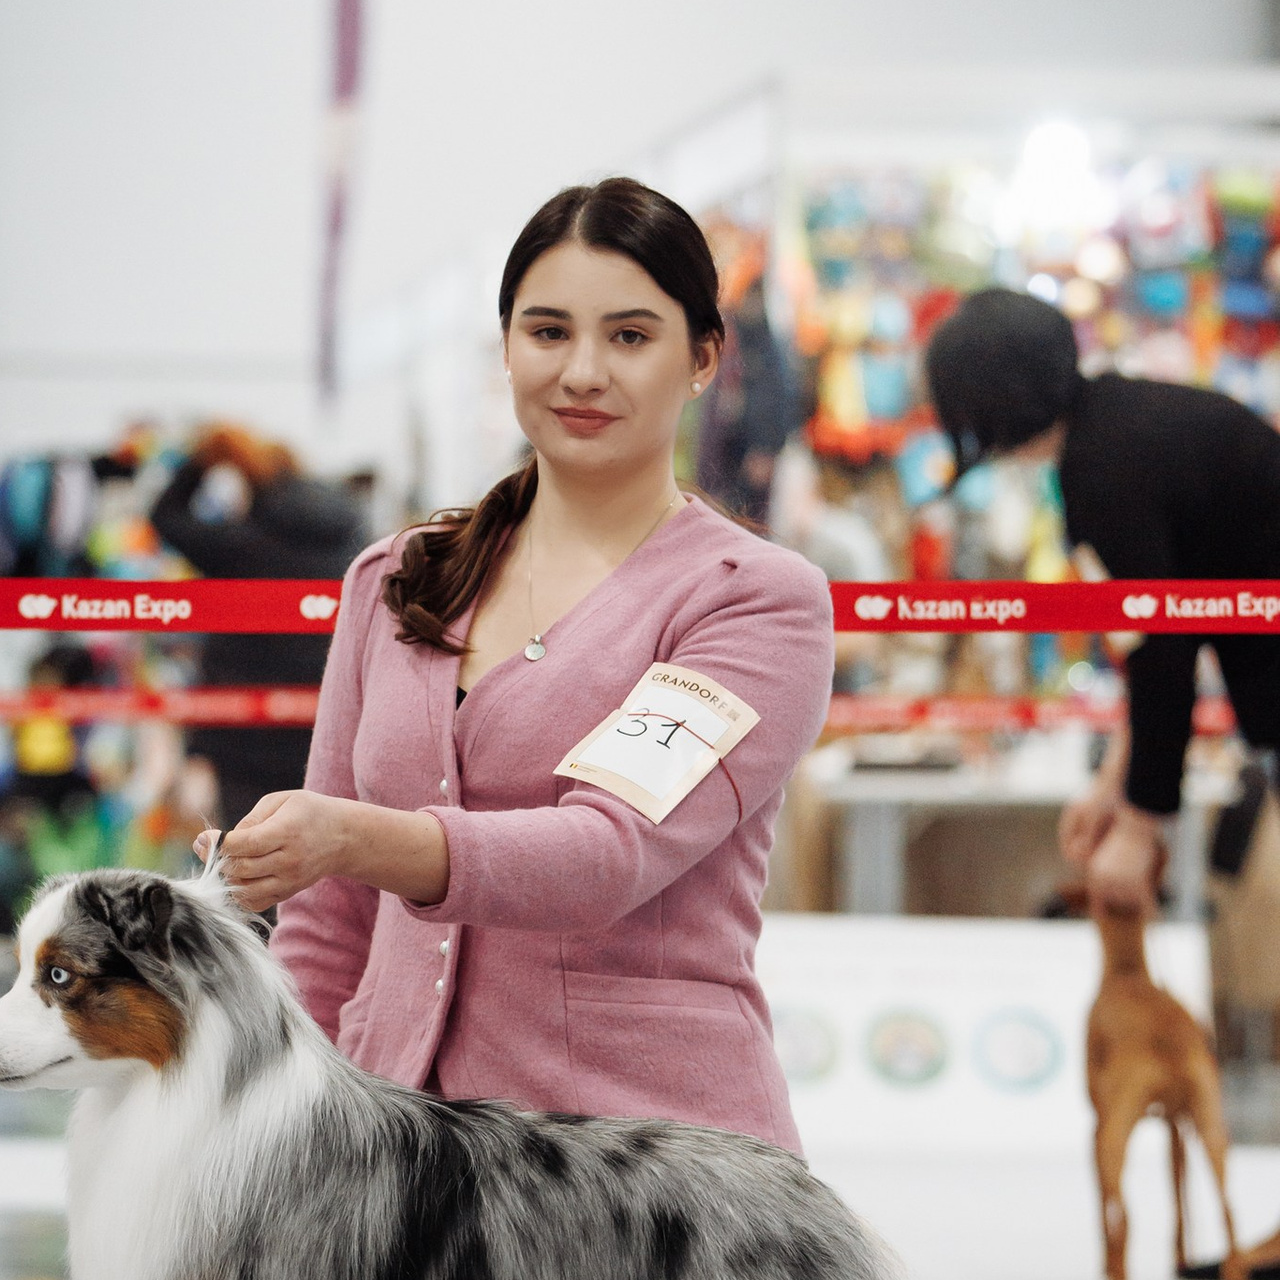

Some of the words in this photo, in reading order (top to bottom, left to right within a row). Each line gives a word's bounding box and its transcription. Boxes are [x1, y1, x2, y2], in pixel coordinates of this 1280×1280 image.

[61, 593, 131, 619] Kazan
[134, 593, 192, 625] Expo
[1165, 593, 1234, 619] Kazan
[1237, 591, 1280, 622] Exp
[651, 672, 729, 711] GRANDORF
[616, 707, 687, 750] 31
